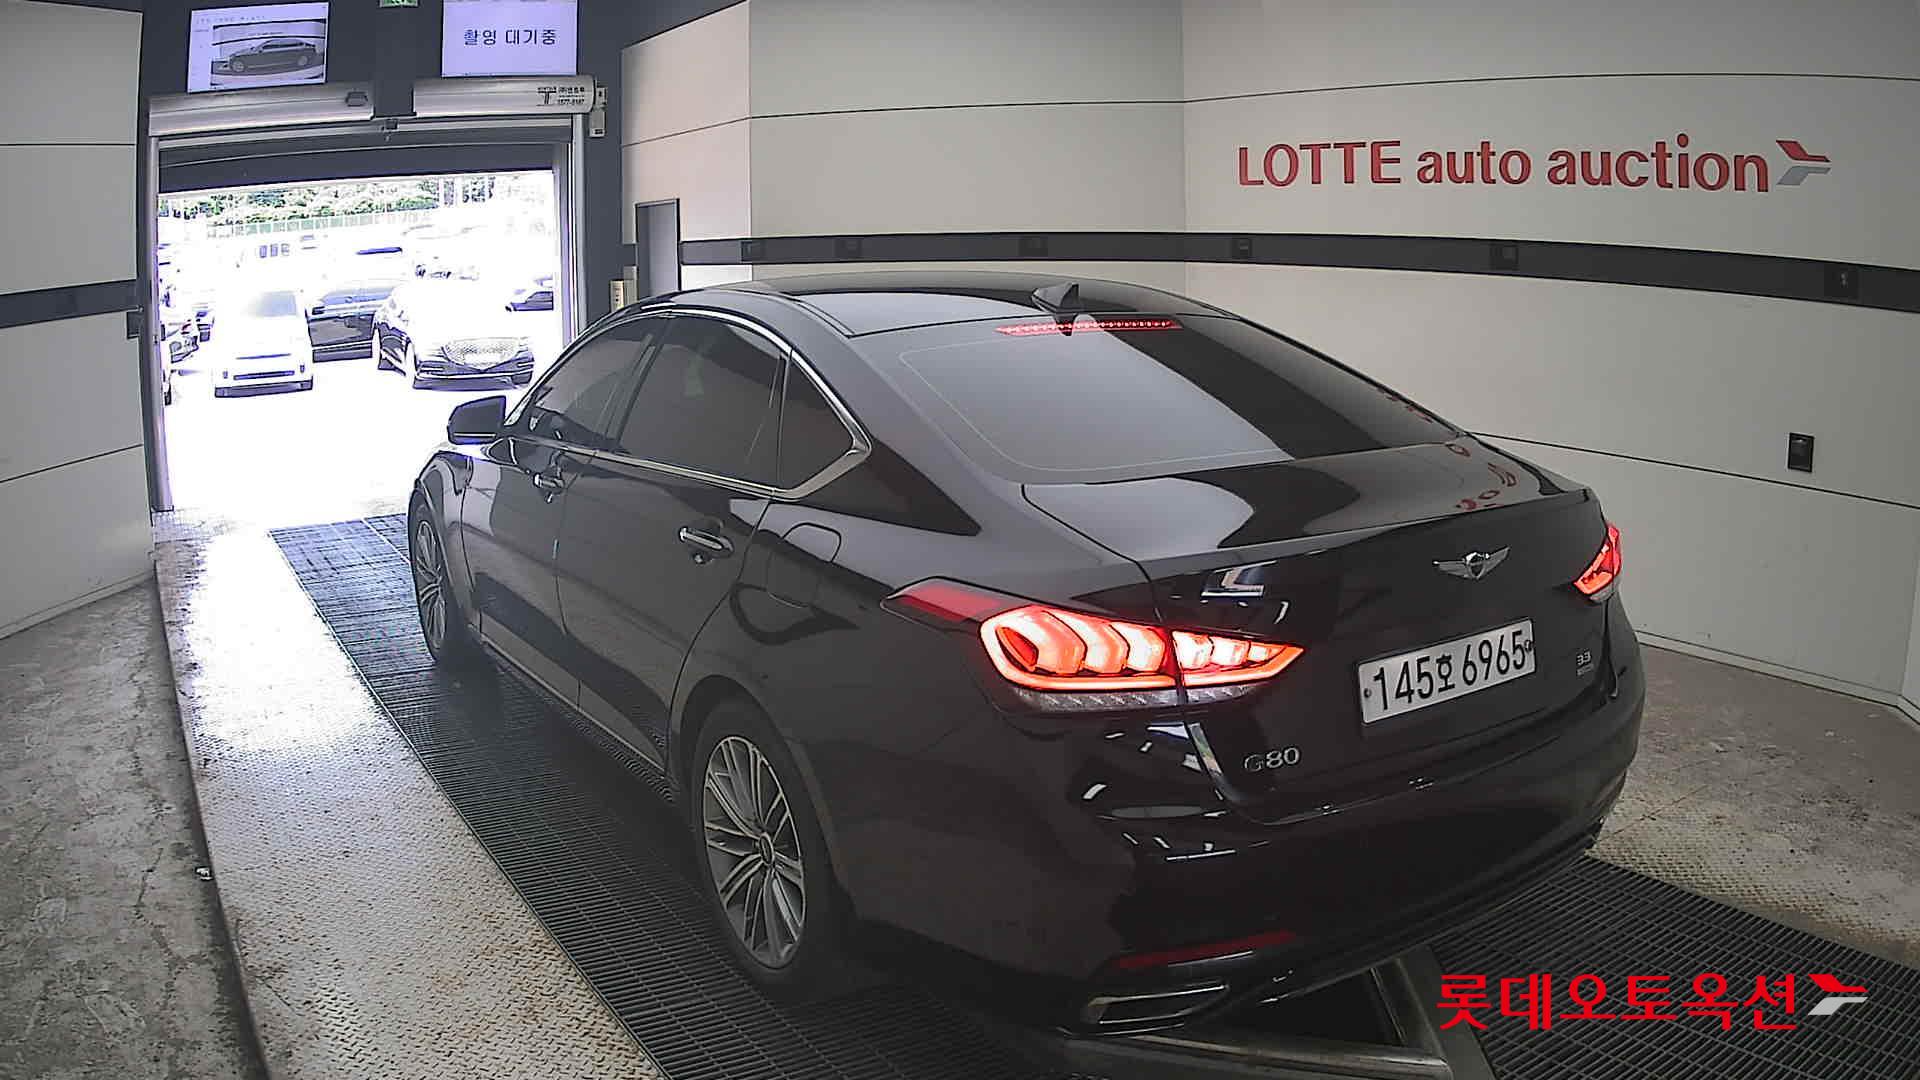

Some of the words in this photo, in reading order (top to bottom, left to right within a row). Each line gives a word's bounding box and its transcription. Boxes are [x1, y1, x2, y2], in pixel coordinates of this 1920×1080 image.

[505, 29, 557, 46] 대기중
[1238, 140, 1401, 187] LOTTE
[1416, 140, 1532, 185] auto
[1547, 132, 1769, 193] auction
[1462, 629, 1526, 686] 6965
[1244, 747, 1300, 772] G80
